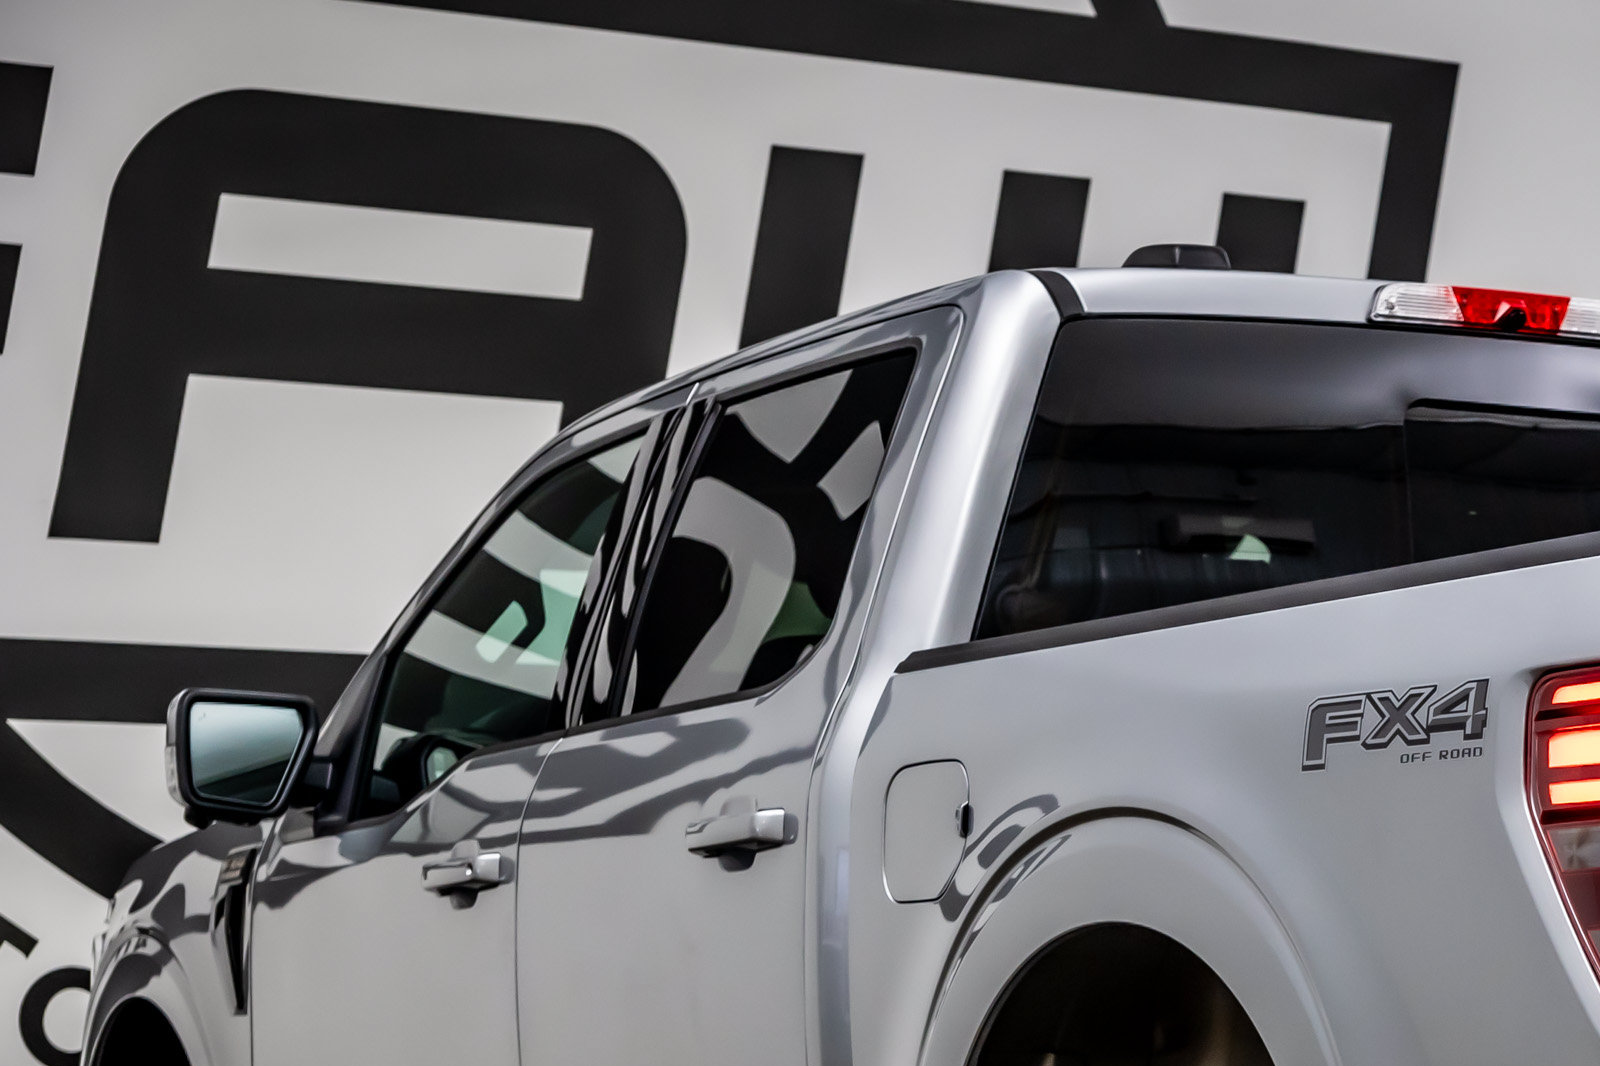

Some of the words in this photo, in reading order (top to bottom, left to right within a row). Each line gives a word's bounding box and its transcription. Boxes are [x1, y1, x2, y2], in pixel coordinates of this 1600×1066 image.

[1301, 678, 1490, 772] FX4
[1400, 751, 1432, 764] OFF
[1438, 746, 1483, 761] ROAD
